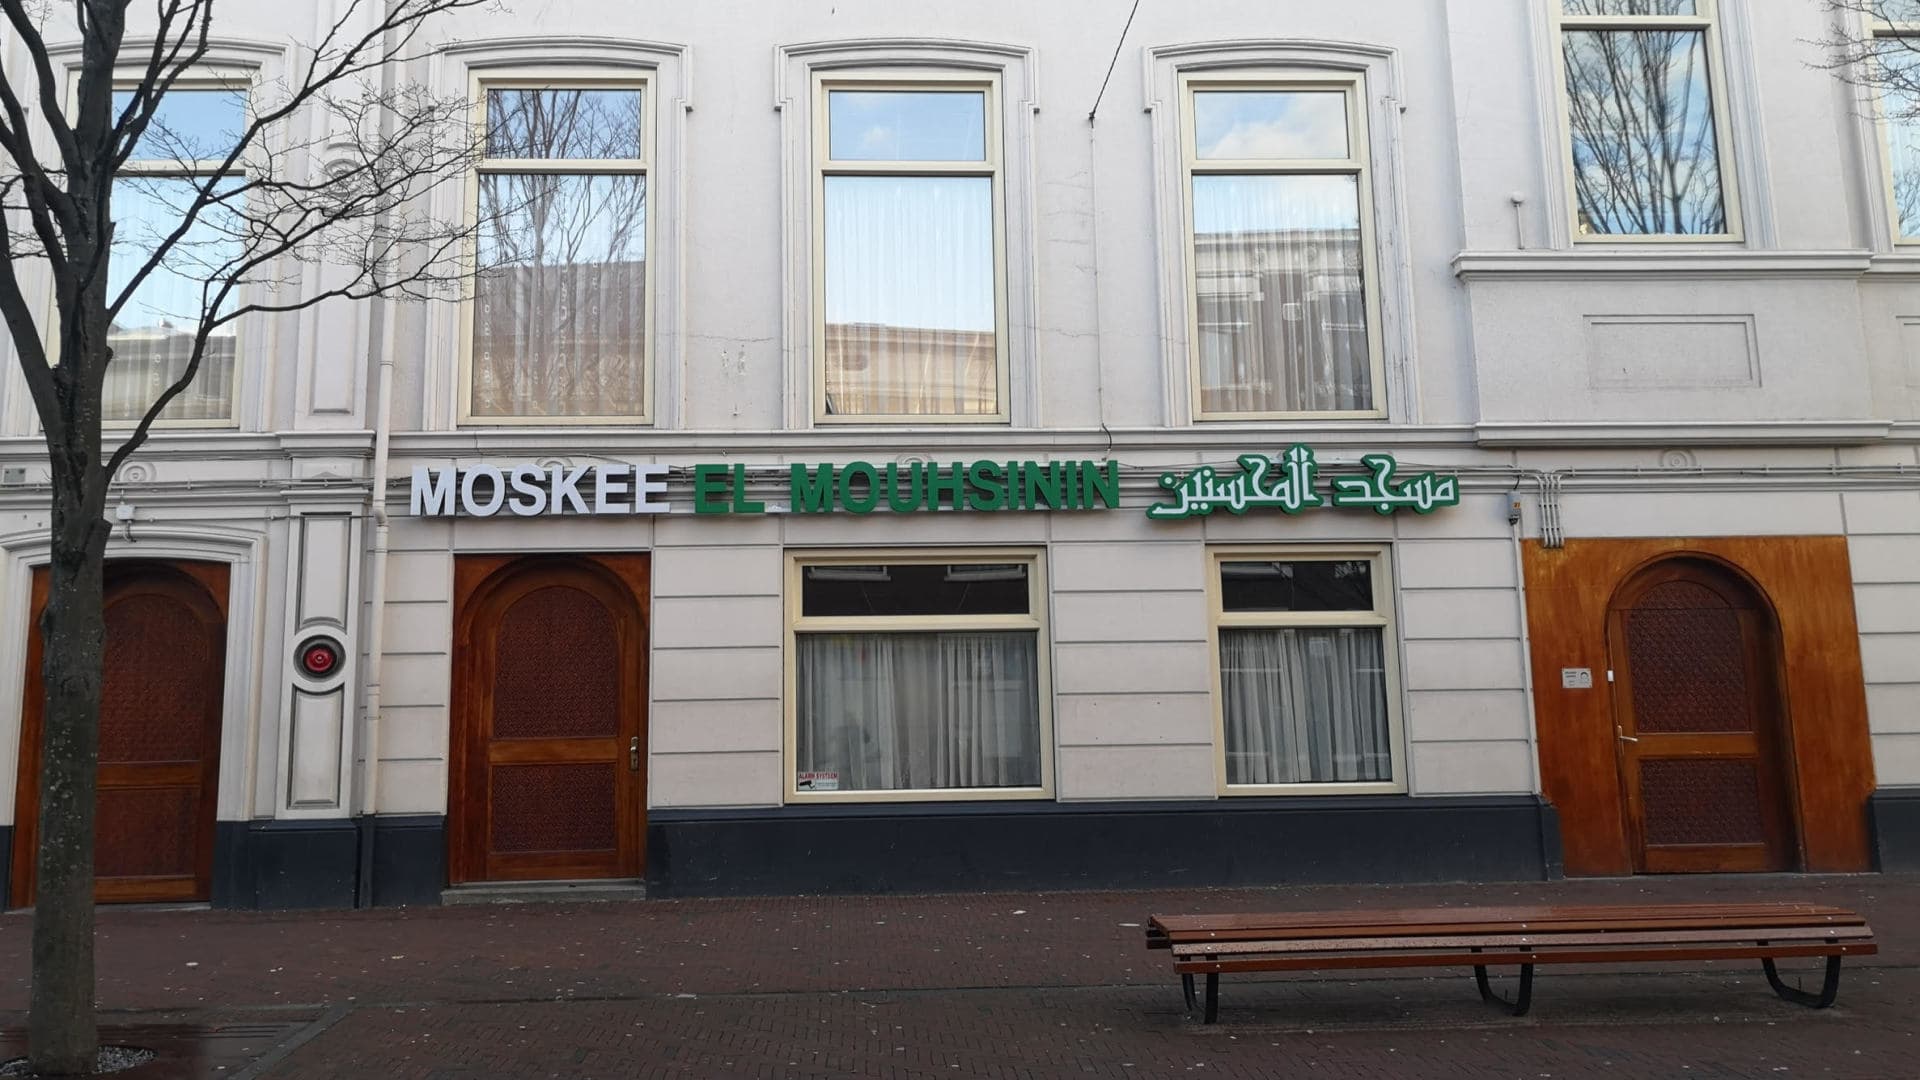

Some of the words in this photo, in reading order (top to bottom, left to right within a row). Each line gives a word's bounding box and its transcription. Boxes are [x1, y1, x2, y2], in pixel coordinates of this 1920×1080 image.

[410, 464, 670, 517] MOSKEE
[695, 463, 765, 514] EL
[790, 460, 1120, 514] MOUHSININ
[1148, 444, 1322, 517] المحسنين
[1334, 456, 1458, 513] مسجد
